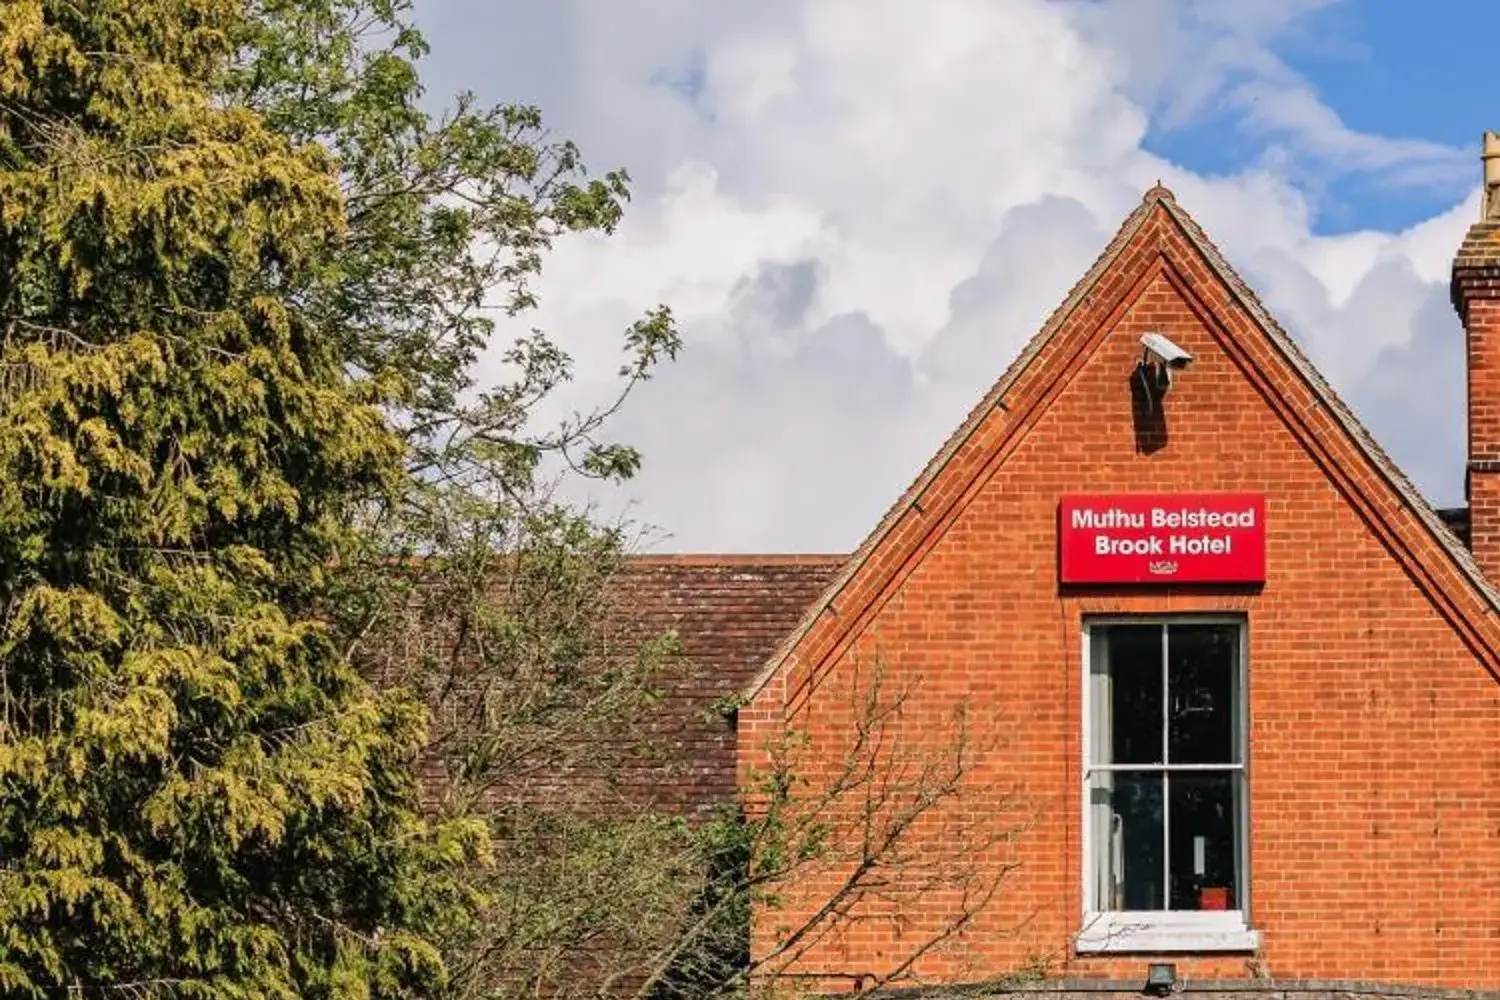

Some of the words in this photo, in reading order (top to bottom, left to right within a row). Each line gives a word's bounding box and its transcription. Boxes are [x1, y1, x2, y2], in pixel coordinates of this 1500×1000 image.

[1071, 508, 1145, 529] Muthu
[1151, 508, 1255, 528] Belstead
[1095, 535, 1163, 555] Brook
[1169, 535, 1231, 555] Hotel
